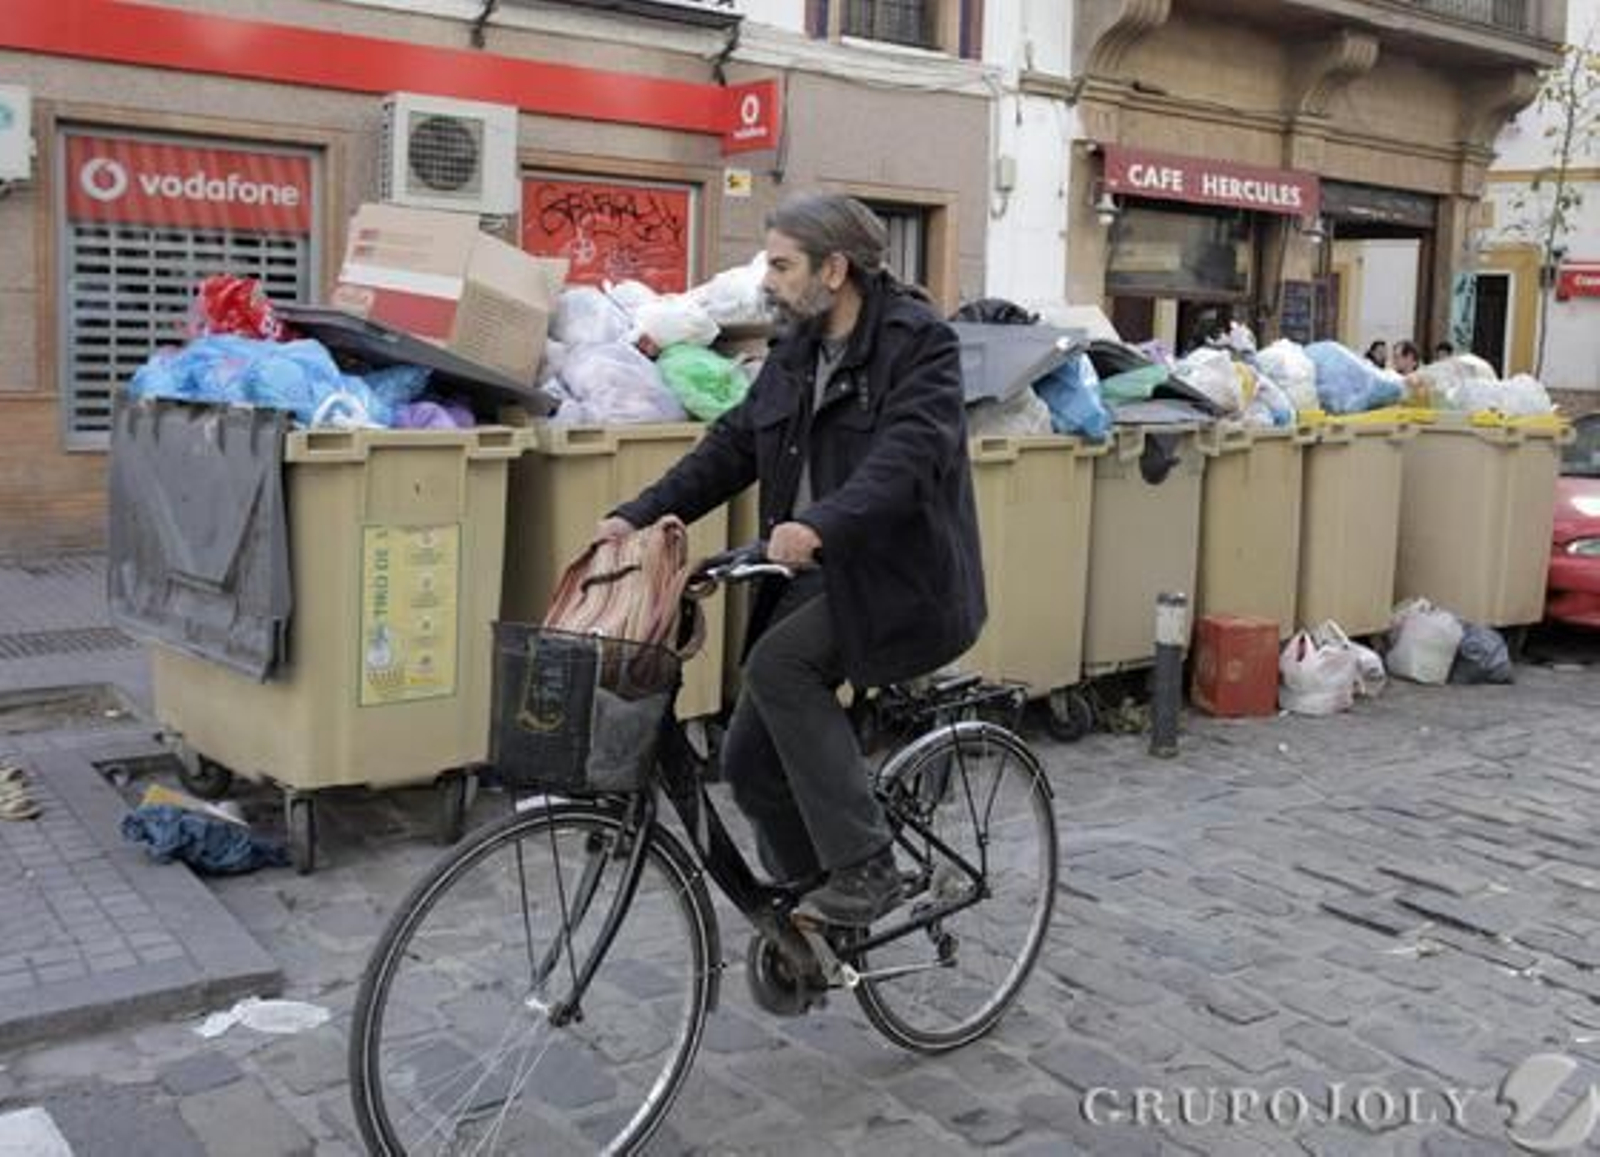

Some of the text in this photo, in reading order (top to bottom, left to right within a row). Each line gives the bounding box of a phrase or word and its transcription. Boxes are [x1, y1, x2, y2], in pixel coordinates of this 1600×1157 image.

[138, 171, 299, 206] vodafone
[1127, 164, 1301, 207] CAFE HERCULES
